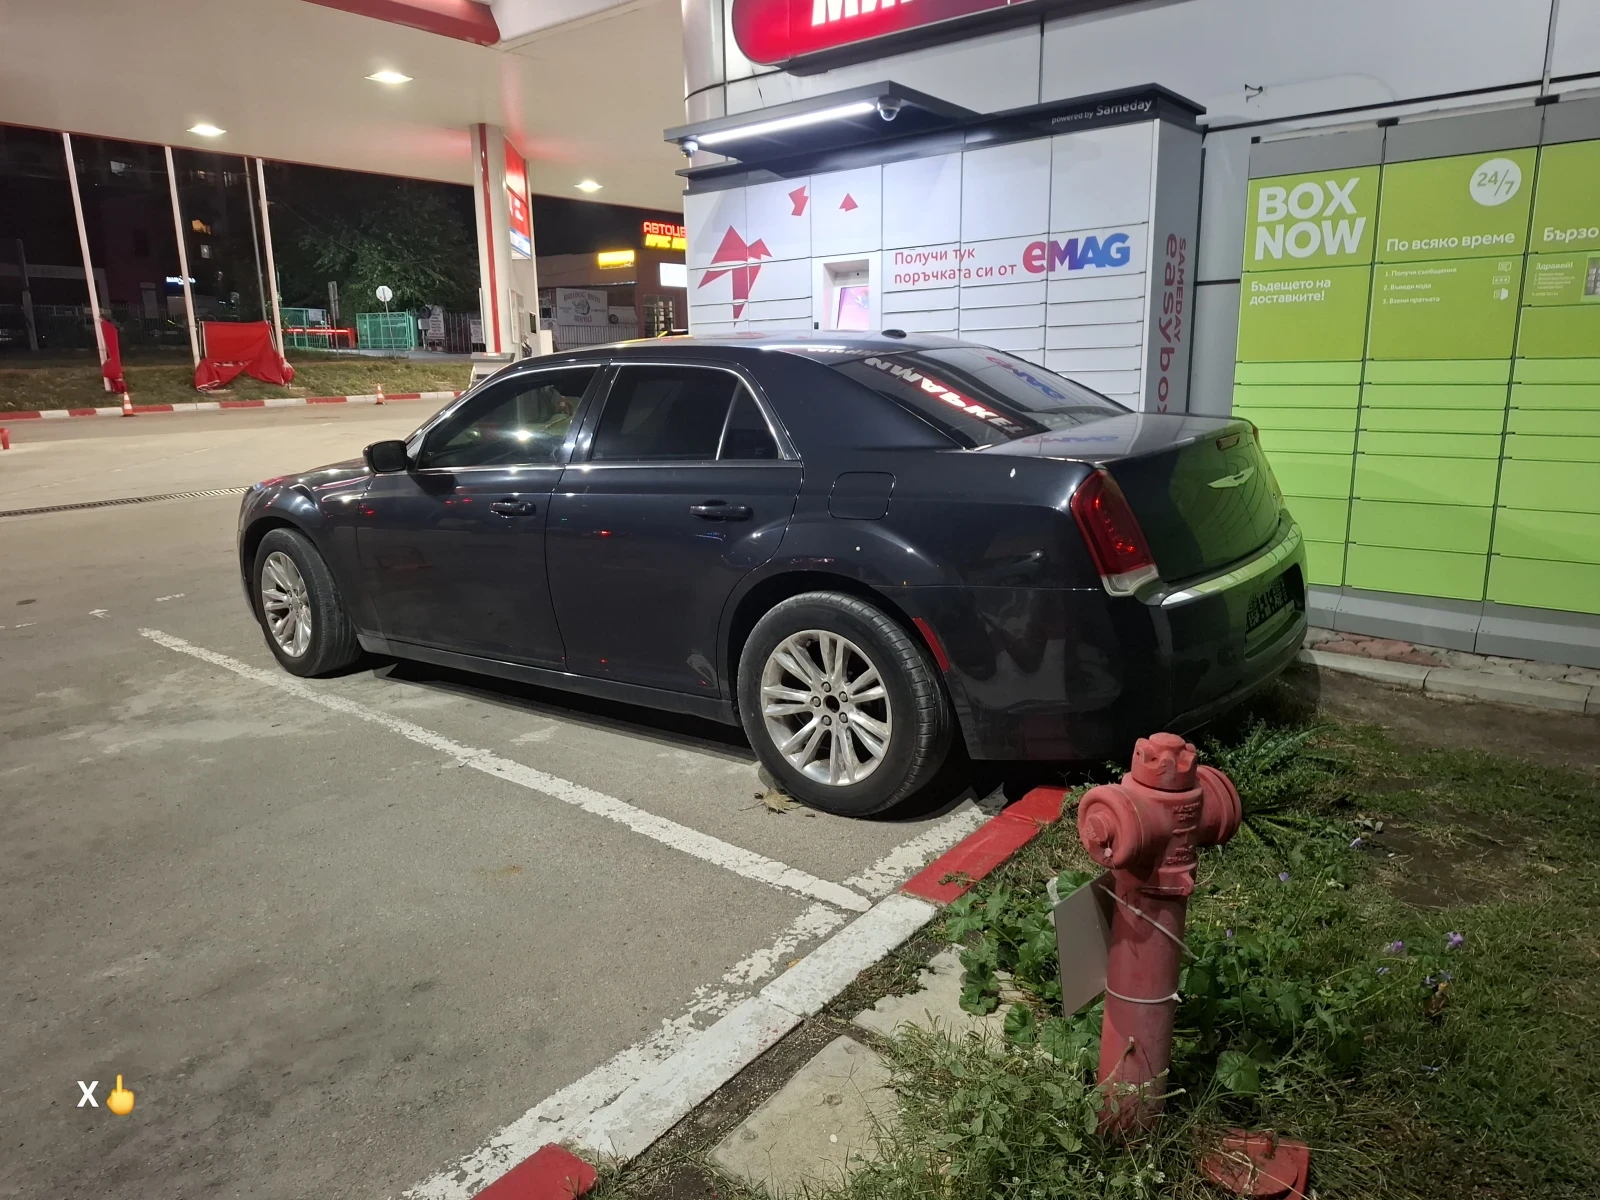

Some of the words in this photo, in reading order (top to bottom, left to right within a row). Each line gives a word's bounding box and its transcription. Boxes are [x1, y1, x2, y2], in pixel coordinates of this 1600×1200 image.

[1051, 112, 1083, 125] powered
[1084, 110, 1094, 119] by
[1096, 99, 1153, 116] Sameday
[1476, 169, 1515, 197] 24/7
[1258, 177, 1360, 222] BOX
[1255, 217, 1366, 260] NOW
[1386, 238, 1409, 252] По
[1412, 237, 1459, 250] всяко
[1462, 233, 1516, 249] време
[1543, 227, 1600, 244] Бързо
[894, 250, 948, 266] Получи
[952, 248, 976, 264] тук
[1022, 232, 1131, 274] eMAG
[894, 267, 971, 287] поръчката
[976, 266, 993, 278] си
[998, 264, 1017, 277] от
[1251, 280, 1314, 293] Бъдещето
[1315, 279, 1331, 289] на
[1173, 237, 1187, 343] SAMEDAY
[1249, 290, 1325, 306] доставките!
